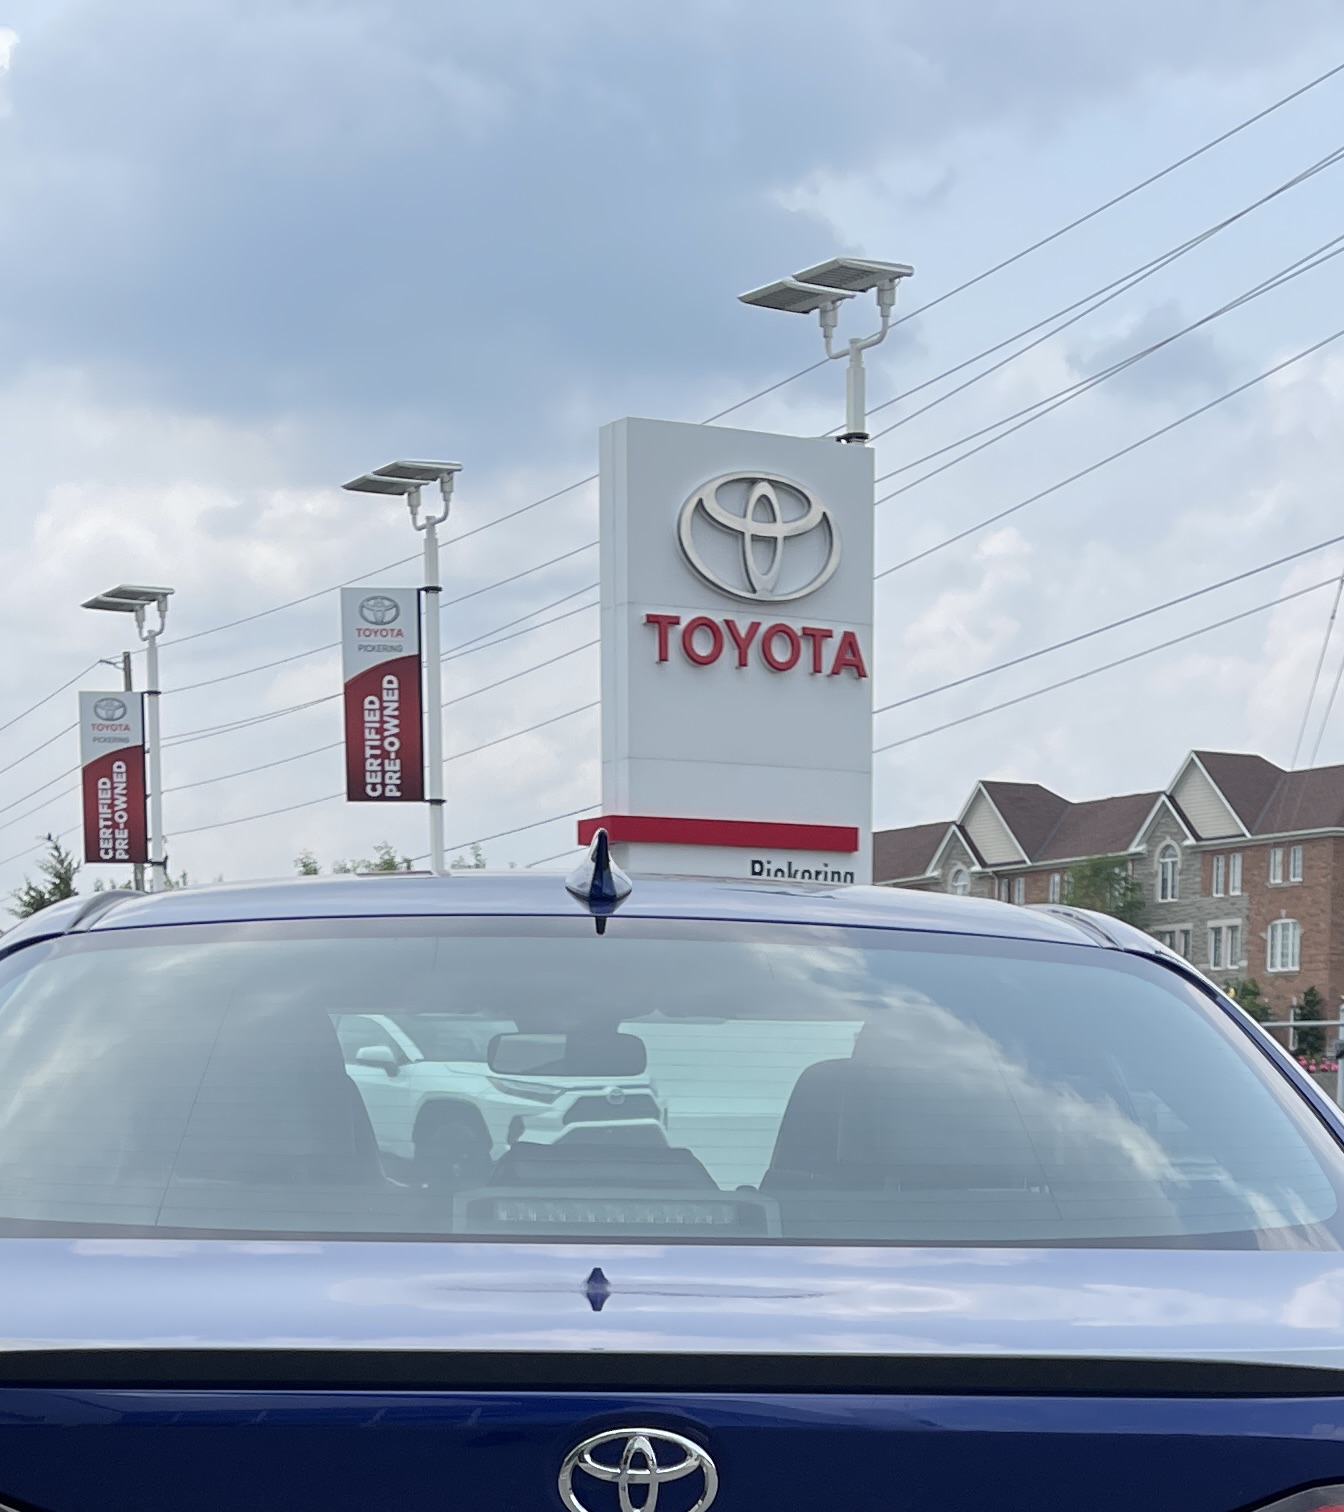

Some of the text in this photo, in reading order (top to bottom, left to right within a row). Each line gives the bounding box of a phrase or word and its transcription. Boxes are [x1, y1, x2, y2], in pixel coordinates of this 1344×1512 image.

[356, 628, 404, 638] TOYOTA
[358, 644, 403, 653] PICKERING
[645, 613, 867, 679] TOYOTA
[91, 723, 130, 732] TOYOTA
[364, 695, 382, 798] CERTIFIED
[382, 674, 402, 797] PRE-OWNED
[97, 777, 113, 860] CERTIFIED
[112, 760, 129, 860] PRE-OWNED
